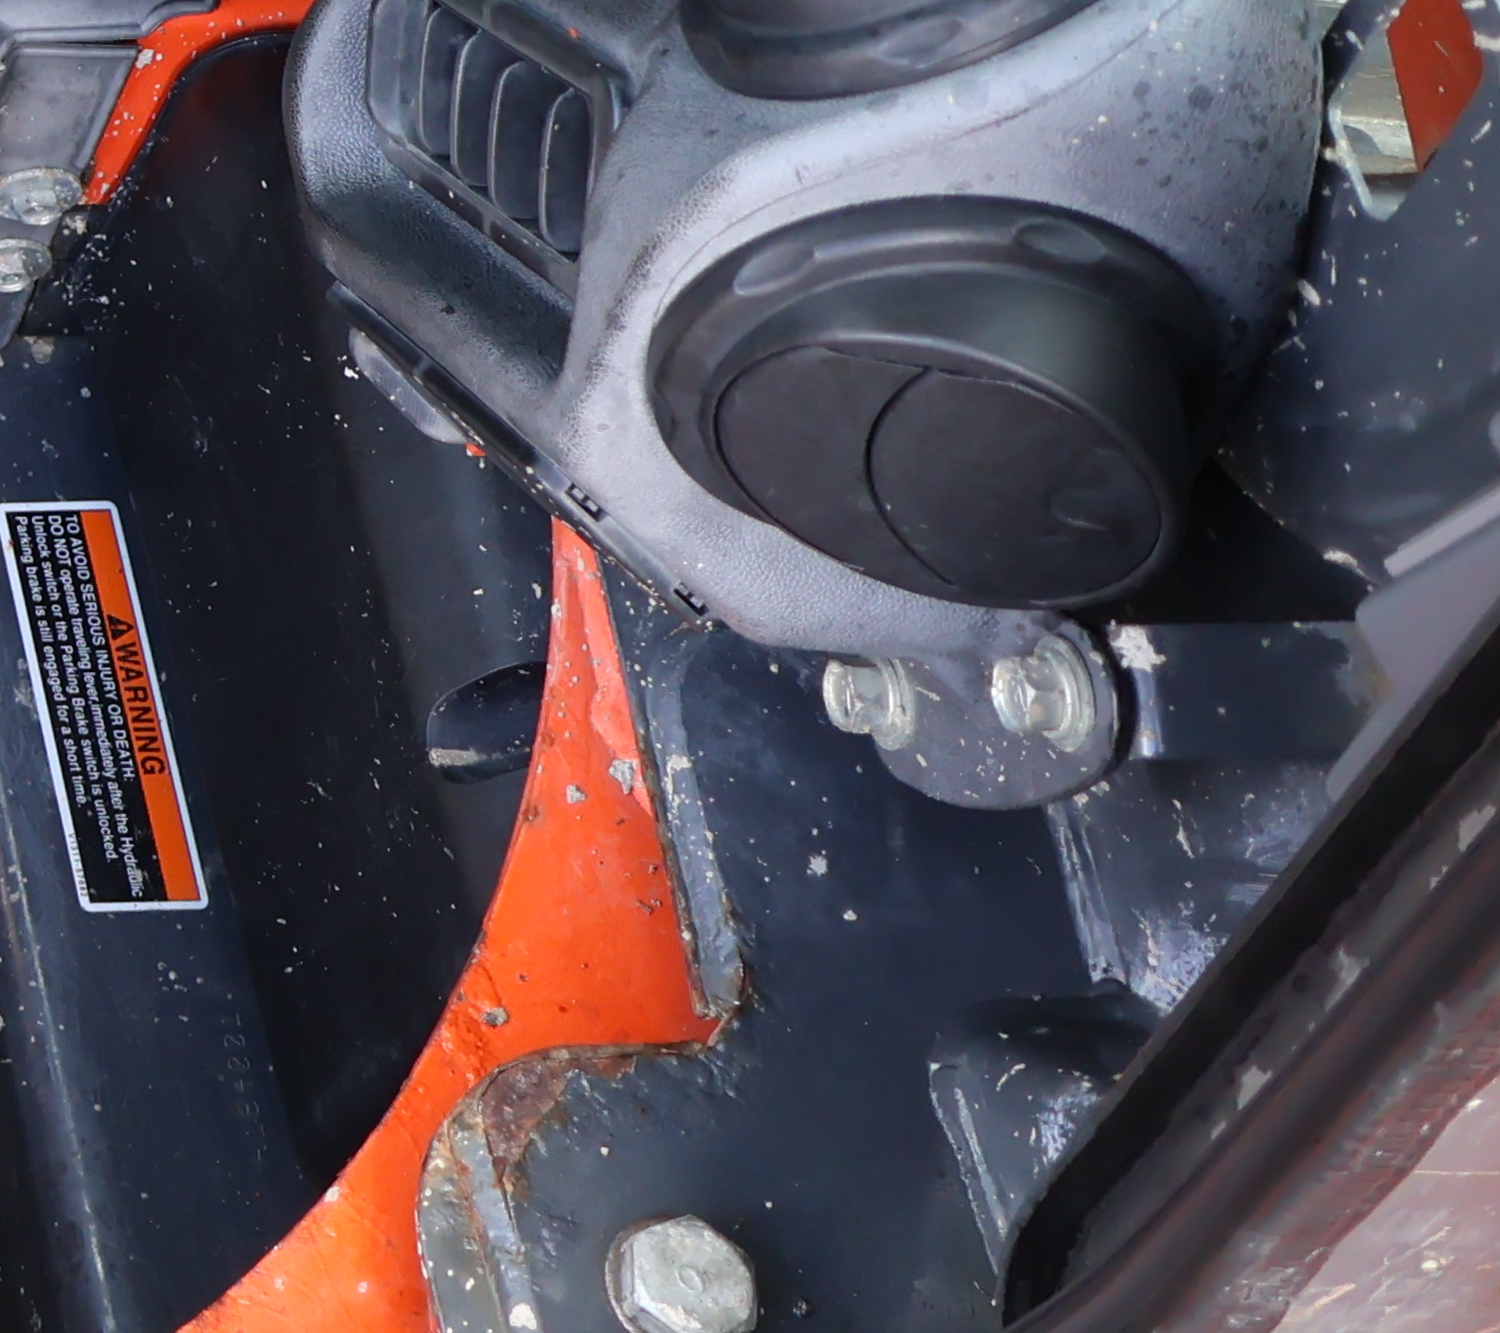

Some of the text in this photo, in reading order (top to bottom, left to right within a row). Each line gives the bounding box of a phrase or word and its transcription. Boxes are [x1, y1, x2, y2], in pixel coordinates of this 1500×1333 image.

[46, 514, 65, 536] DO
[52, 537, 72, 566] NOT
[56, 568, 81, 615] operate
[10, 515, 90, 807] Parking brake is still engaged for a short time.
[63, 514, 137, 782] TO AVOID SERIOUS INJURY OR DEATH:
[67, 617, 94, 669] traveling
[30, 515, 120, 863] Unlock switch or the Parking Brake switch is unlocked.
[113, 641, 167, 775] WARNING
[106, 781, 126, 810] after
[113, 813, 131, 833] the
[115, 836, 146, 897] Hydraulic
